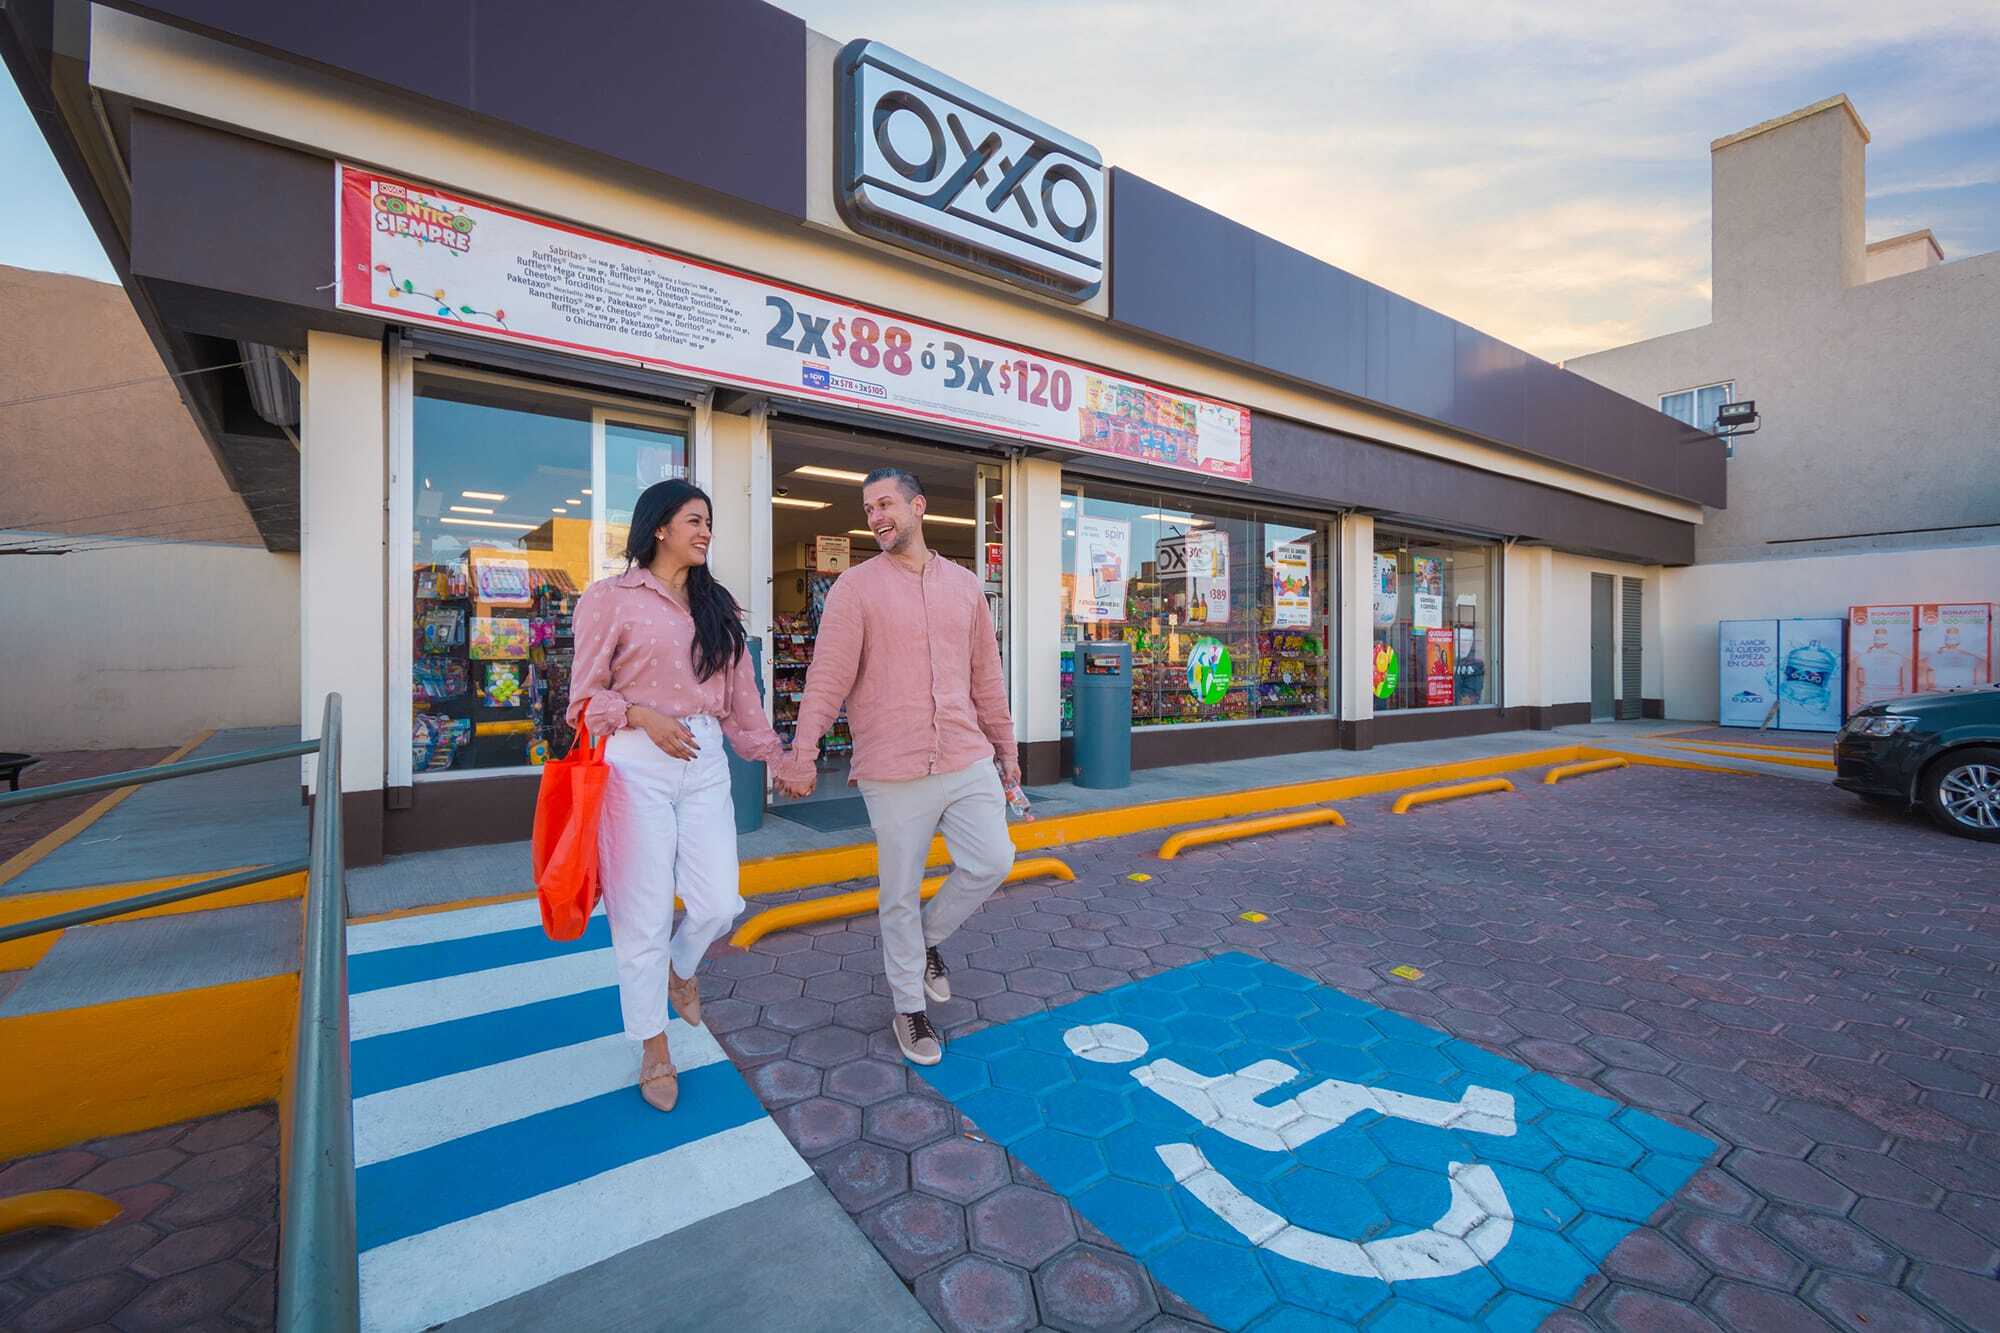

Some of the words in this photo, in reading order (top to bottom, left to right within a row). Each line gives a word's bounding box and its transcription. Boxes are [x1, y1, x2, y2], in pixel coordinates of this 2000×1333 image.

[873, 90, 1097, 242] OXXO
[373, 193, 473, 233] CONTIGO
[376, 212, 470, 252] SIEMPRE
[553, 266, 575, 279] Mega
[577, 271, 605, 284] Crunch
[690, 297, 724, 311] Torciditos
[565, 278, 603, 293] Torciditos
[643, 278, 663, 289] Mega
[665, 281, 690, 295] Crunch
[573, 316, 616, 332] Chicharrón
[631, 327, 652, 338] Cerdo
[921, 342, 936, 370] ó
[1104, 526, 1125, 541] spin
